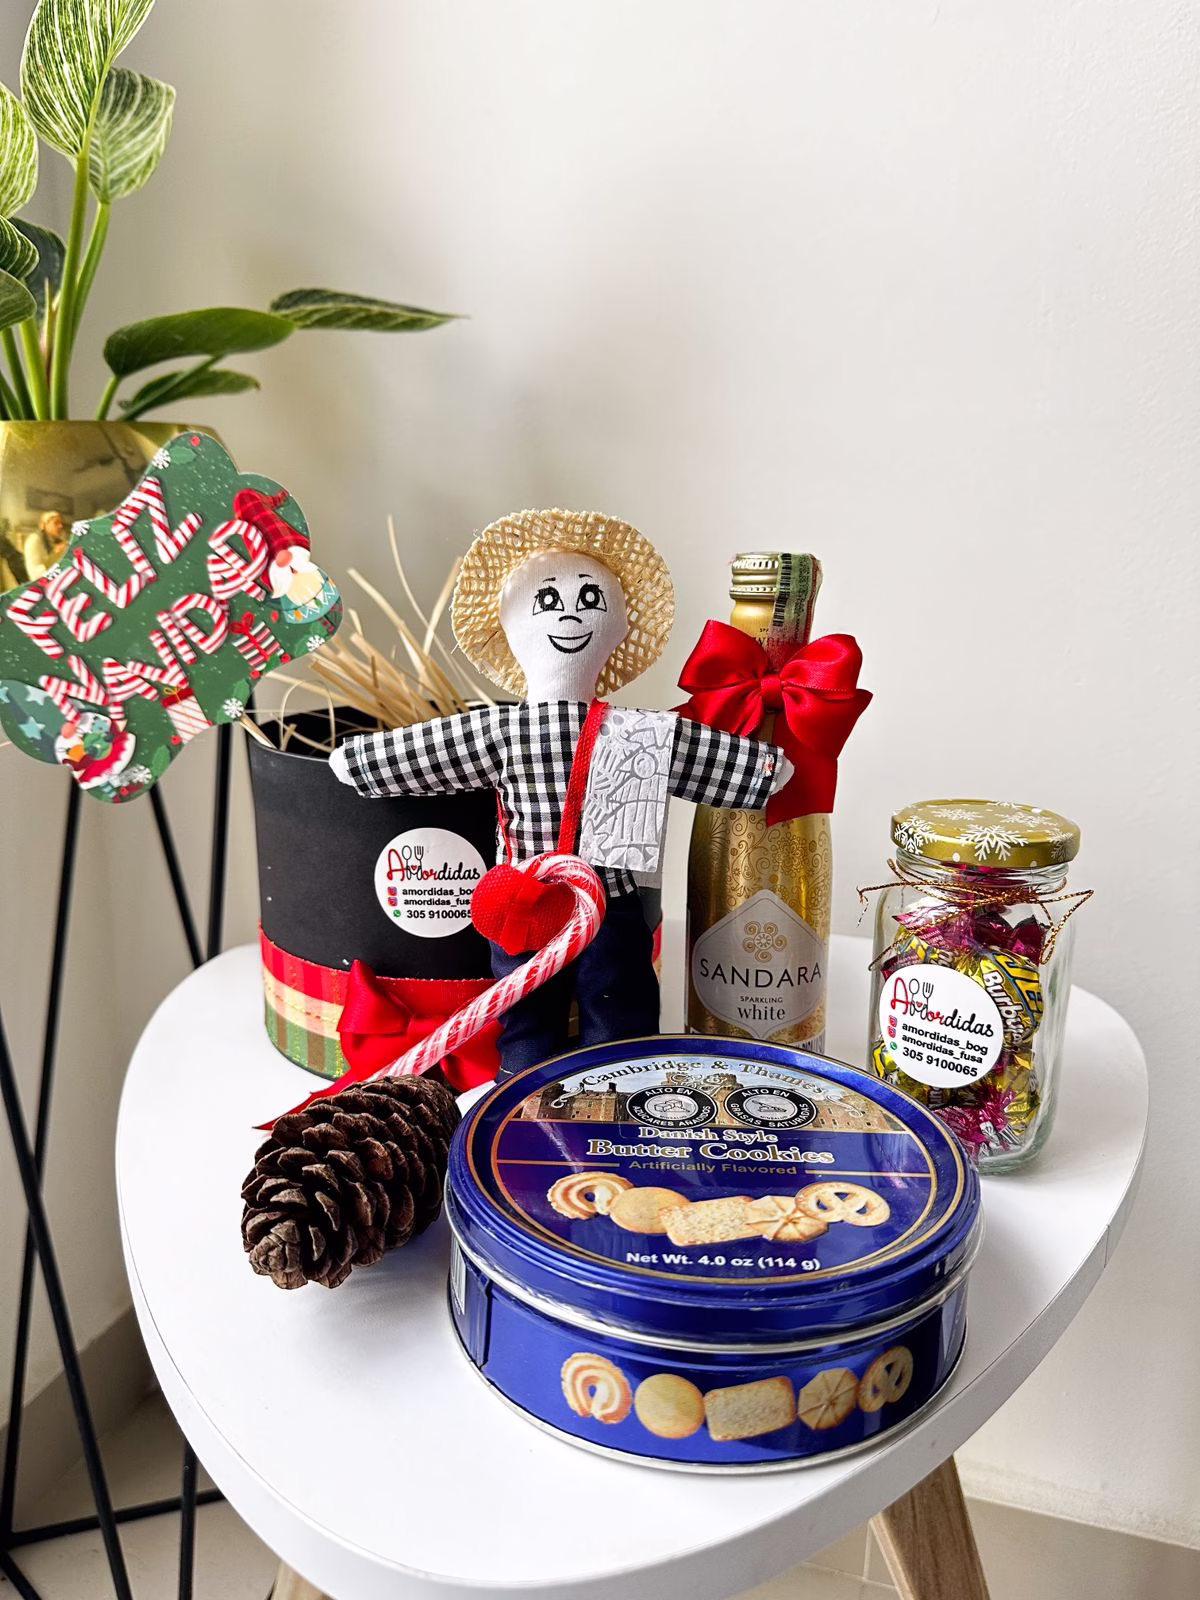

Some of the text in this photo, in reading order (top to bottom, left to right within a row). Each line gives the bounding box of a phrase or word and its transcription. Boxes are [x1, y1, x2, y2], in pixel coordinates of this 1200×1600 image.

[7, 477, 203, 659] FELIZ
[39, 519, 268, 724] NAVIDAD
[387, 845, 480, 881] Amordidas
[404, 898, 471, 907] amordidas_fus
[407, 910, 426, 919] 305
[700, 958, 821, 988] SANDARA
[740, 995, 783, 1003] SPARKLING
[890, 977, 994, 1037] Amordidas
[737, 1004, 786, 1020] white
[902, 1022, 988, 1056] amordidas_bog
[902, 1033, 983, 1064] amordidas_fusa
[902, 1047, 978, 1077] 305 9100065
[581, 1060, 828, 1094] Cambridge & Thames
[645, 1087, 694, 1097] ALTO EN
[741, 1088, 790, 1098] ALTO EN
[730, 1103, 762, 1125] GRASAS
[638, 1127, 778, 1145] Danish Style
[586, 1138, 835, 1164] Butter Cookies
[629, 1161, 798, 1175] Artificially Flavored
[626, 1252, 821, 1272] Net Wt. 4.0 oz (114 g)
